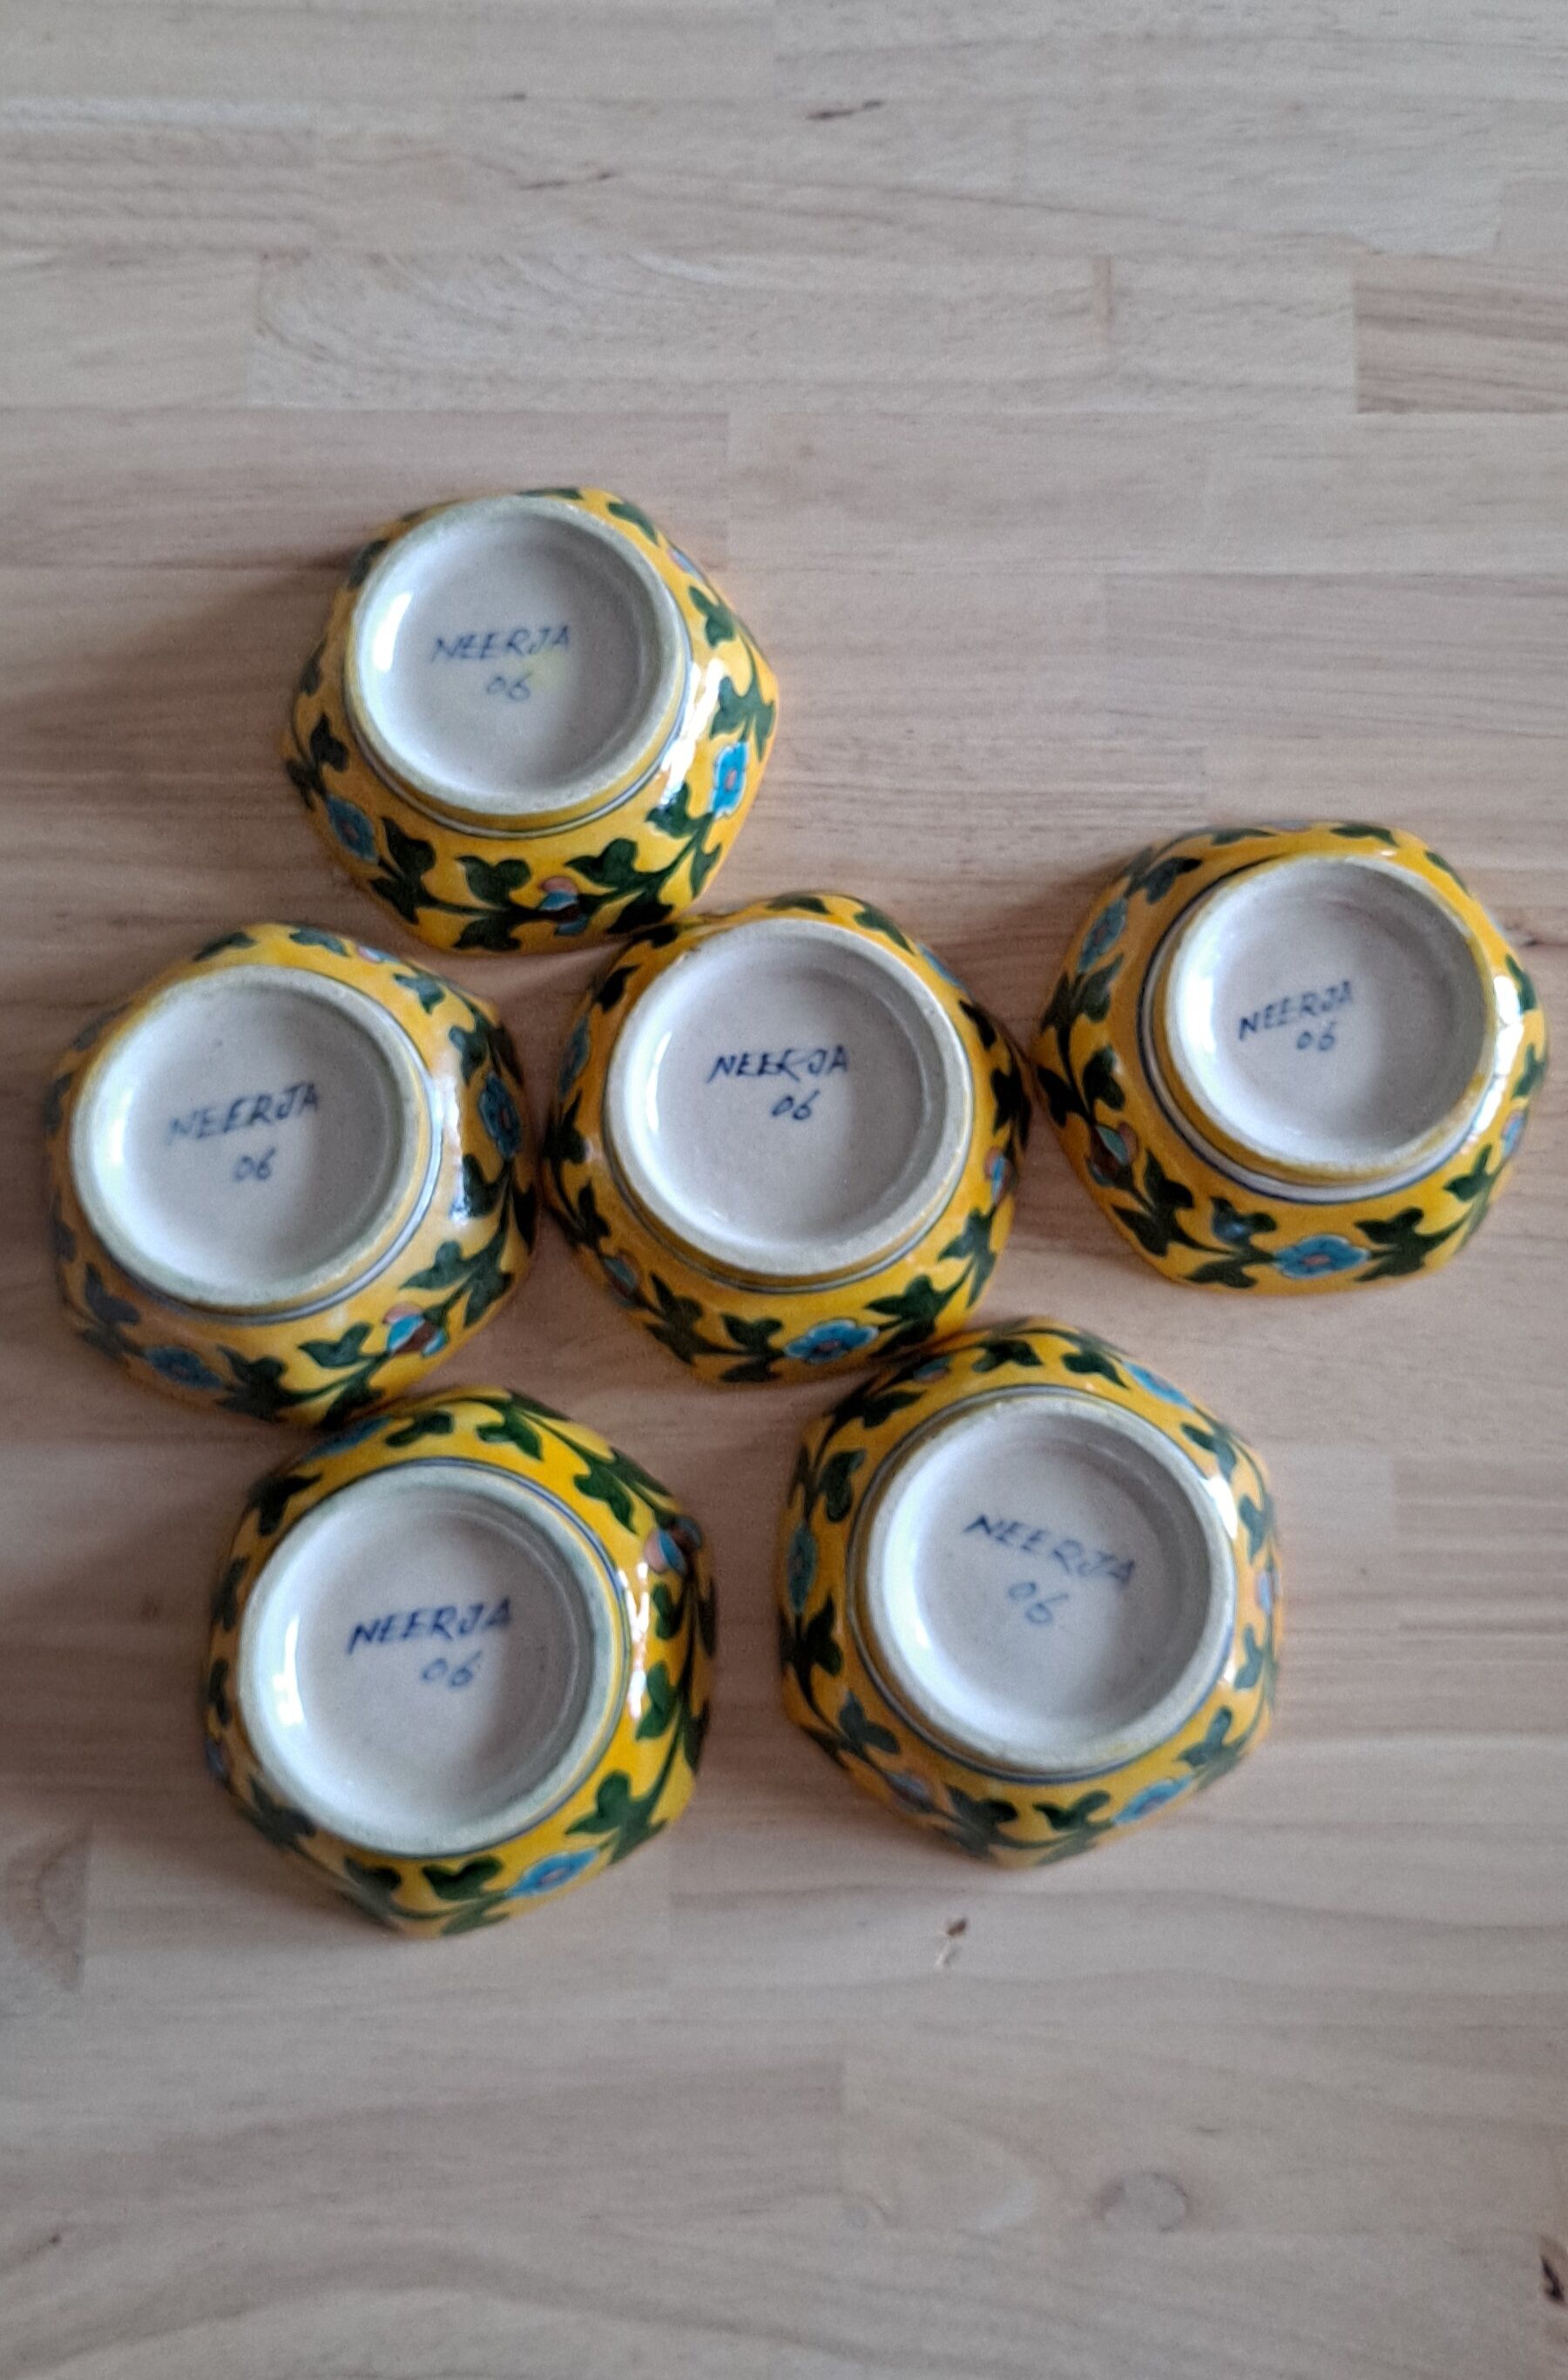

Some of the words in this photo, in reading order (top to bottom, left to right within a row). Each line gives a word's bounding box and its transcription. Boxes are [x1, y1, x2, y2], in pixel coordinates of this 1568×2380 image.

[1238, 980, 1354, 1041] NEERJA
[1296, 1021, 1337, 1051] 06
[706, 1045, 848, 1083] NEERJA
[166, 1082, 321, 1146] NEERJA
[771, 1090, 821, 1121] 06
[233, 1146, 276, 1182] 06
[963, 1514, 1136, 1589] NEERJA
[1007, 1581, 1069, 1626] 06
[347, 1597, 512, 1655] NEERJA
[421, 1650, 482, 1688] 06
